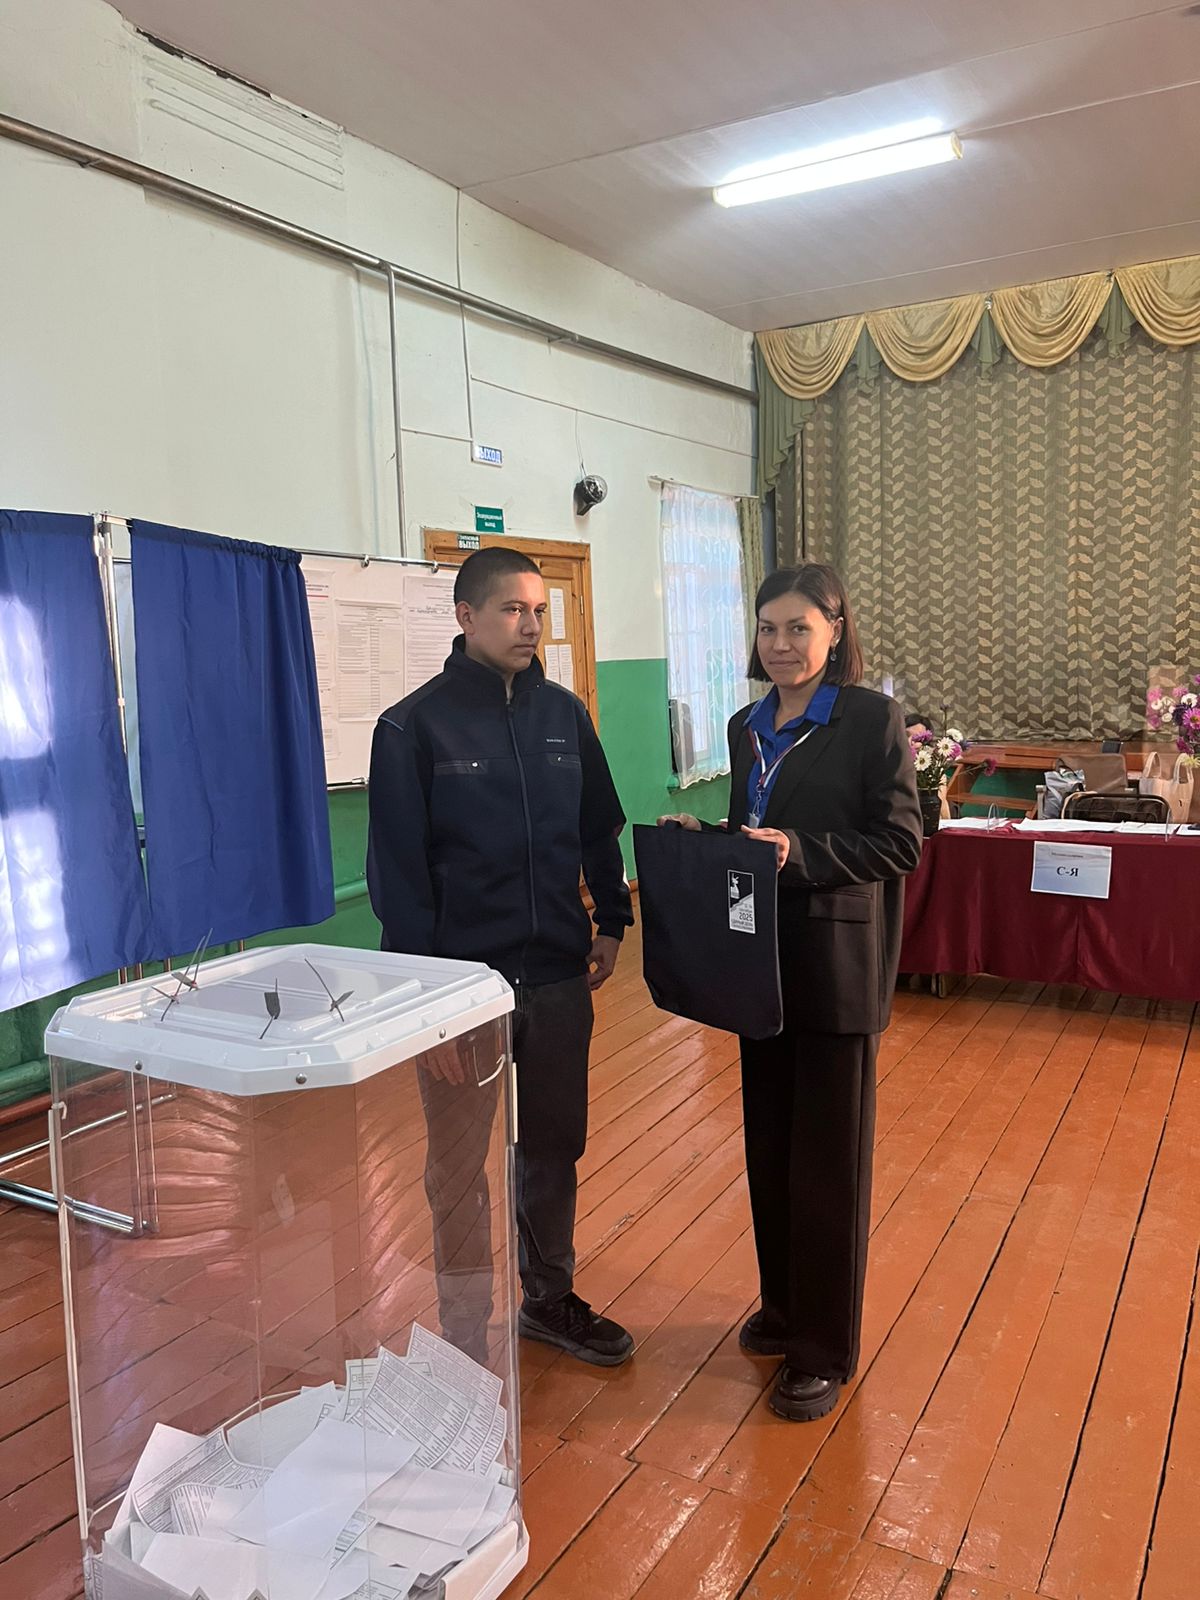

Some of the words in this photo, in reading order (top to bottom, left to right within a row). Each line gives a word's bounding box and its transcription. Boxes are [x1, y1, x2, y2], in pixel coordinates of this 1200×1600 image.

[474, 446, 501, 463] ЫХОД
[1056, 866, 1079, 877] С-Я
[739, 911, 753, 922] 2025
